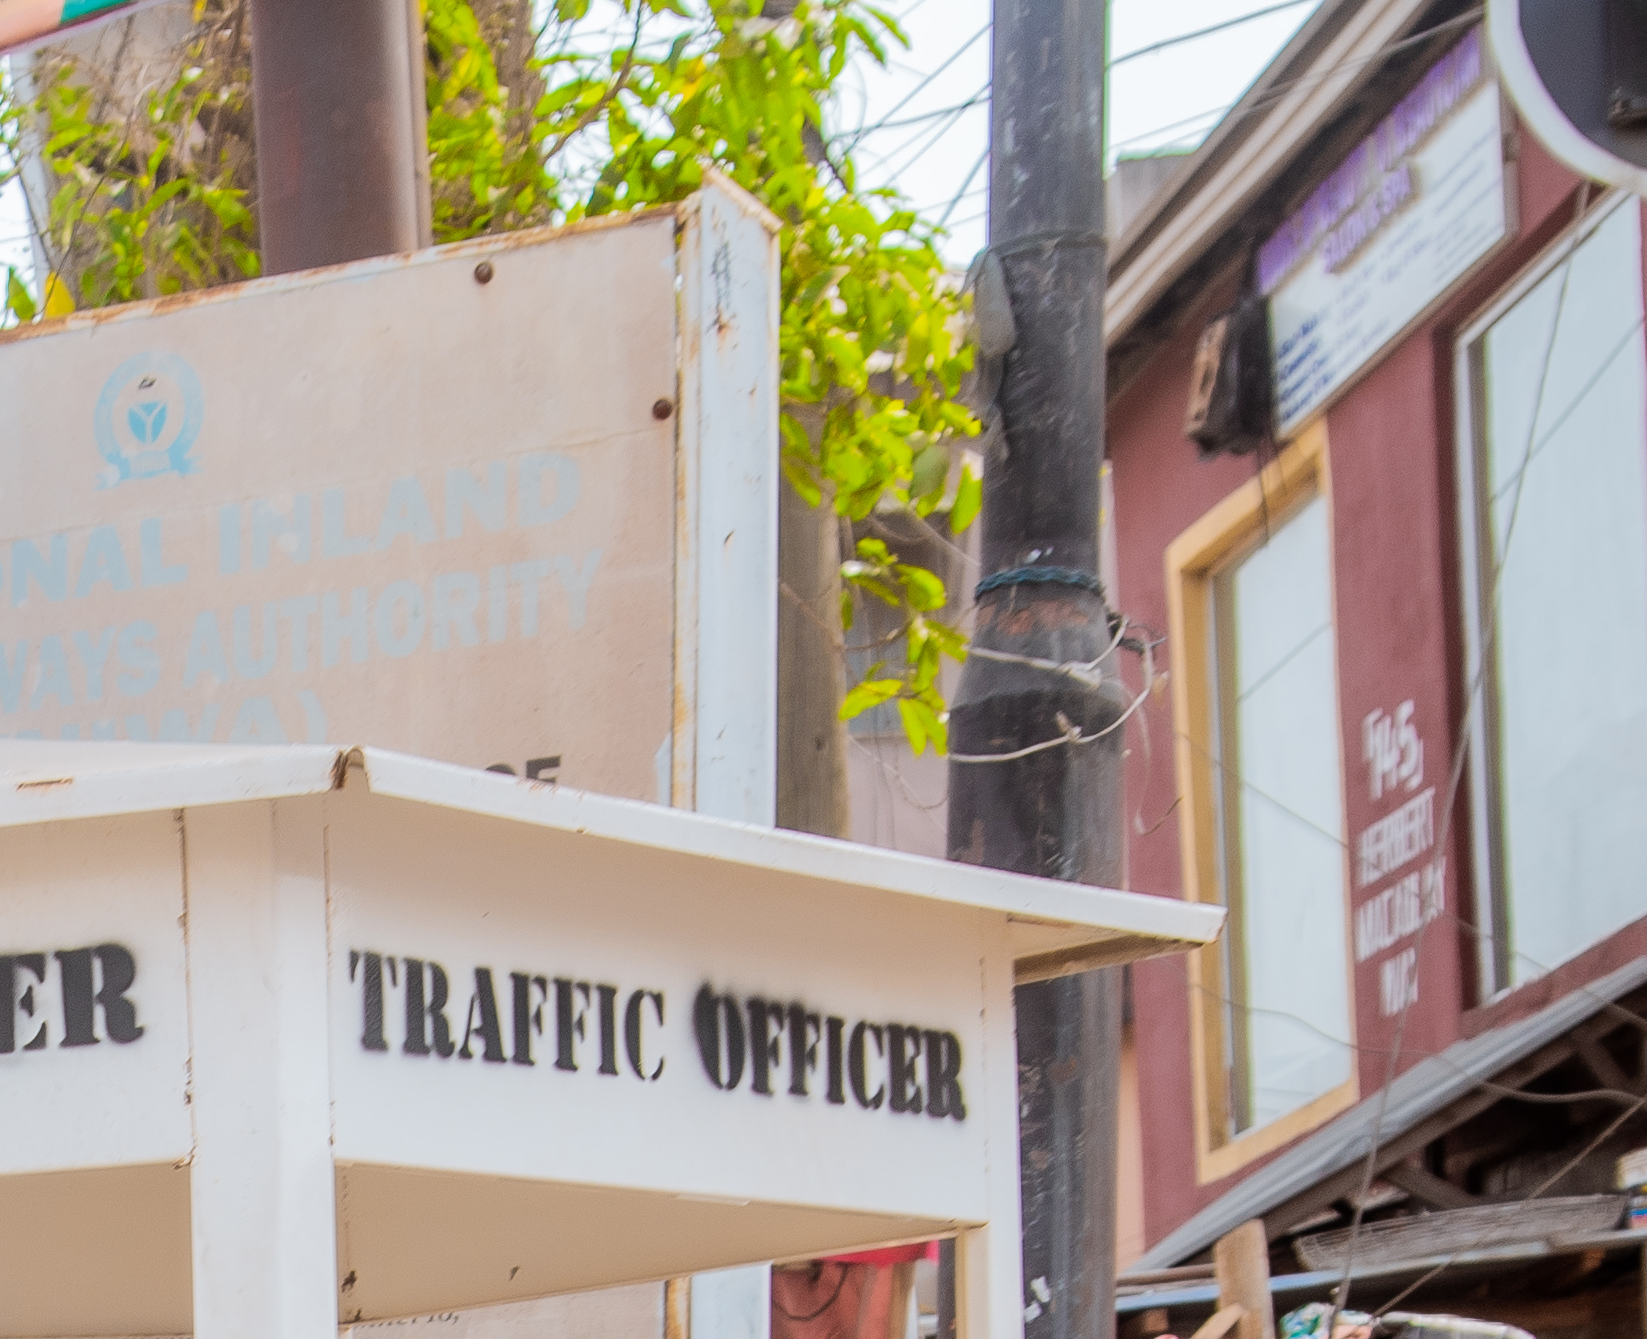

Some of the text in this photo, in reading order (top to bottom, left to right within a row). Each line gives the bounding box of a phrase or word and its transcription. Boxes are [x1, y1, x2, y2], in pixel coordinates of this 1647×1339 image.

[219, 454, 581, 575] INLAND
[183, 549, 604, 688] AUTHORITY
[350, 950, 967, 1121] TRAFFIC OFFICER
